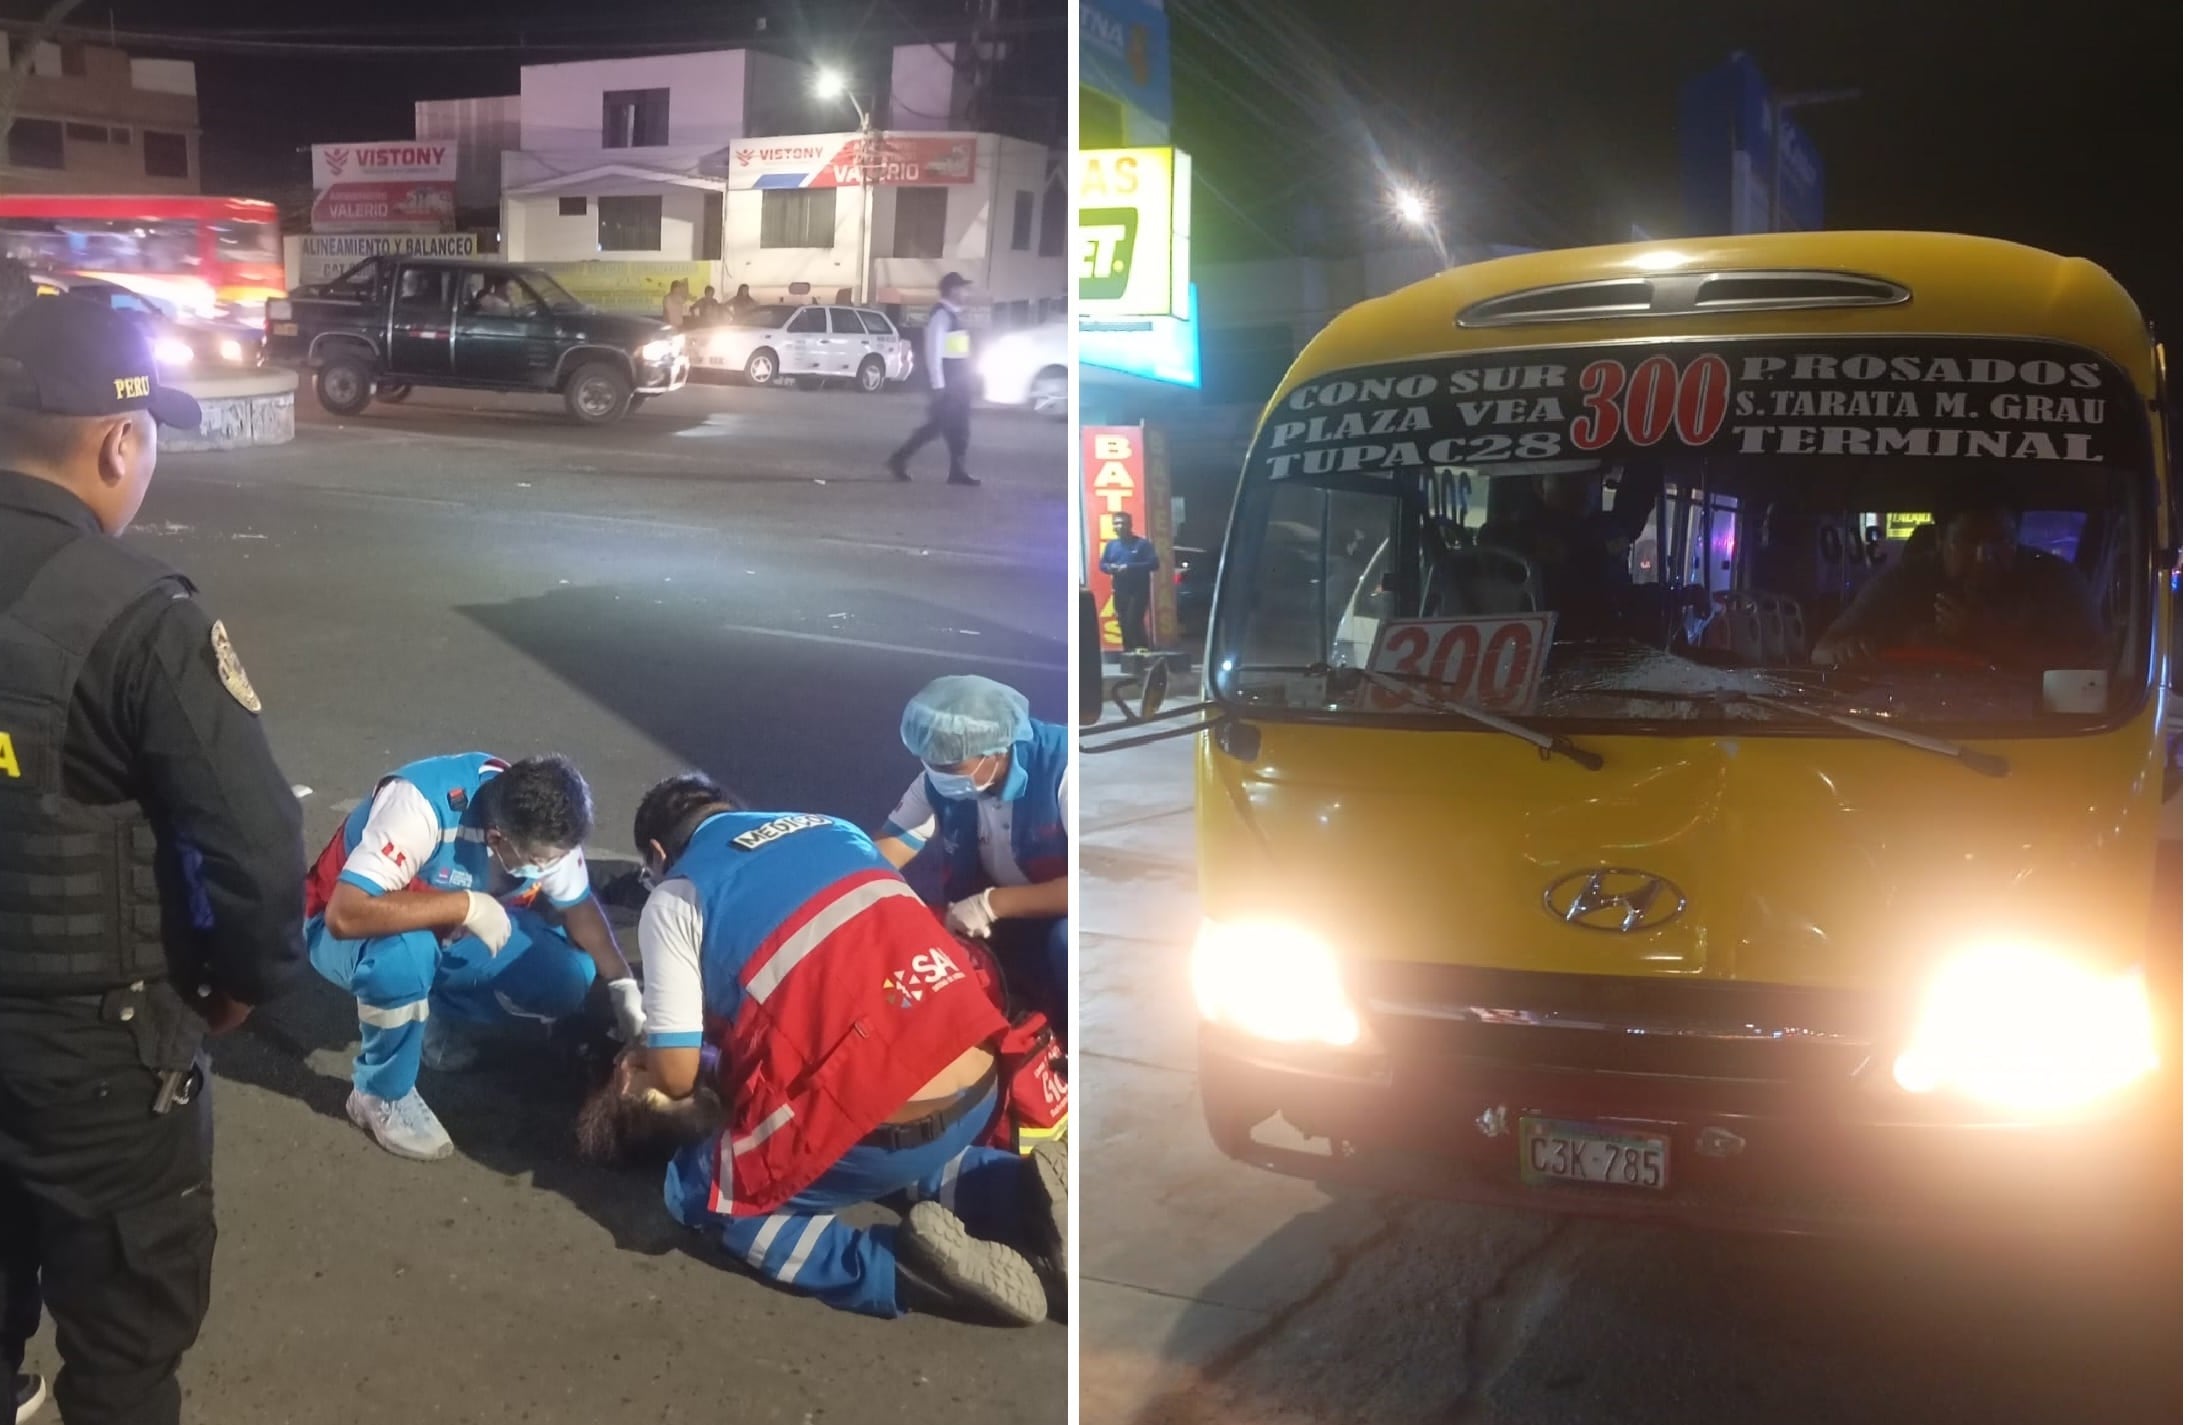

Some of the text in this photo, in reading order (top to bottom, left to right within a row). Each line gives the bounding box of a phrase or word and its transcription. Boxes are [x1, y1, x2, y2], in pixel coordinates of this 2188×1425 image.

[356, 147, 446, 167] VISTONY
[759, 146, 823, 161] VISTONY
[833, 162, 919, 183] VARIO
[328, 203, 388, 217] VALERIO
[303, 237, 473, 255] ALINEAMIENTO Y BALANCEO
[113, 376, 150, 400] PERU
[1289, 364, 1567, 410] CONO SUR
[1569, 353, 1731, 451] 300
[1990, 393, 2106, 424] GRAU
[1270, 397, 1566, 449] PLAZA VEA
[1732, 425, 2104, 462] TERMINAL
[1371, 622, 1533, 709] 300
